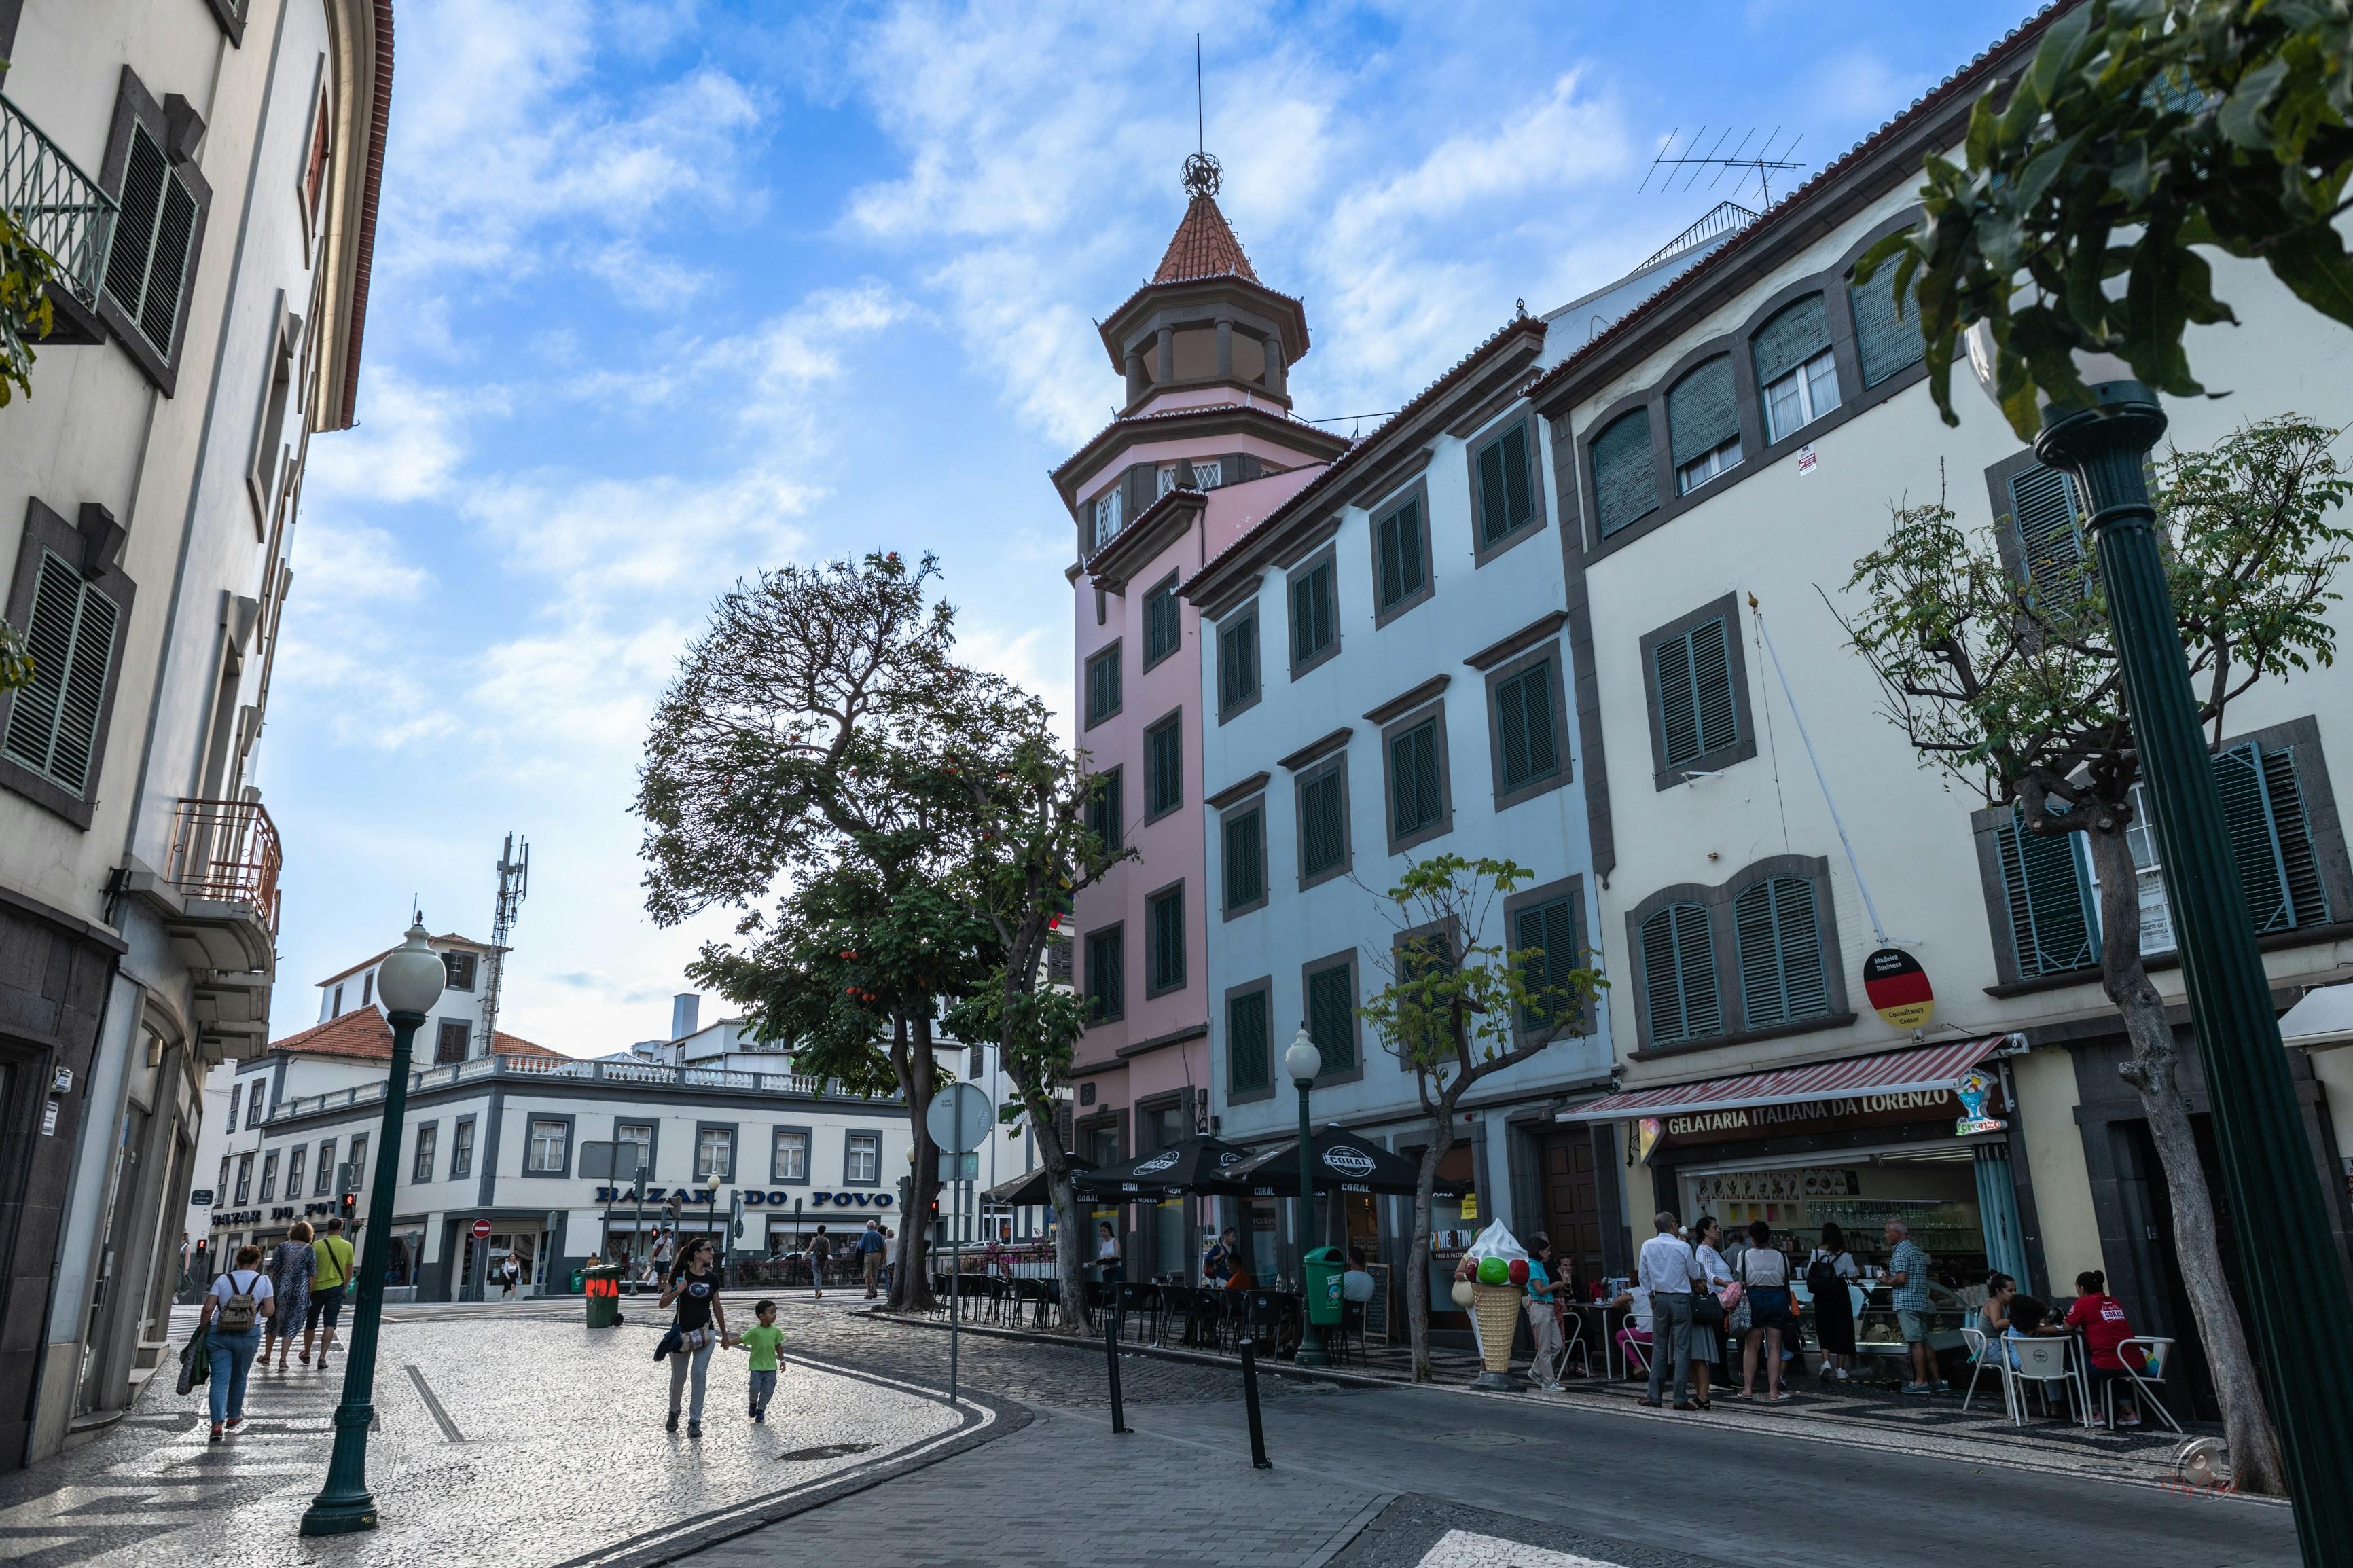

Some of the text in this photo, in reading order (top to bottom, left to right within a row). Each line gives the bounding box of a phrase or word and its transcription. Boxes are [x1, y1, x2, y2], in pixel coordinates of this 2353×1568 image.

[1874, 955, 1899, 964] Madeira
[1876, 962, 1902, 972] Business
[1888, 1007, 1924, 1018] Consultancy
[1899, 1017, 1919, 1025] Center
[1668, 1088, 1950, 1135] GELATARIA ITALIANA DA LORENZO
[1329, 1156, 1369, 1166] CORAL
[1122, 1182, 1138, 1192] CORAL
[1254, 1186, 1275, 1196] CORAL
[1341, 1182, 1371, 1193] CORAL
[595, 1186, 893, 1207] BAZAR DO POVO
[1077, 1195, 1099, 1203] CORAL
[270, 1206, 295, 1220] DO
[304, 1201, 336, 1216] POV
